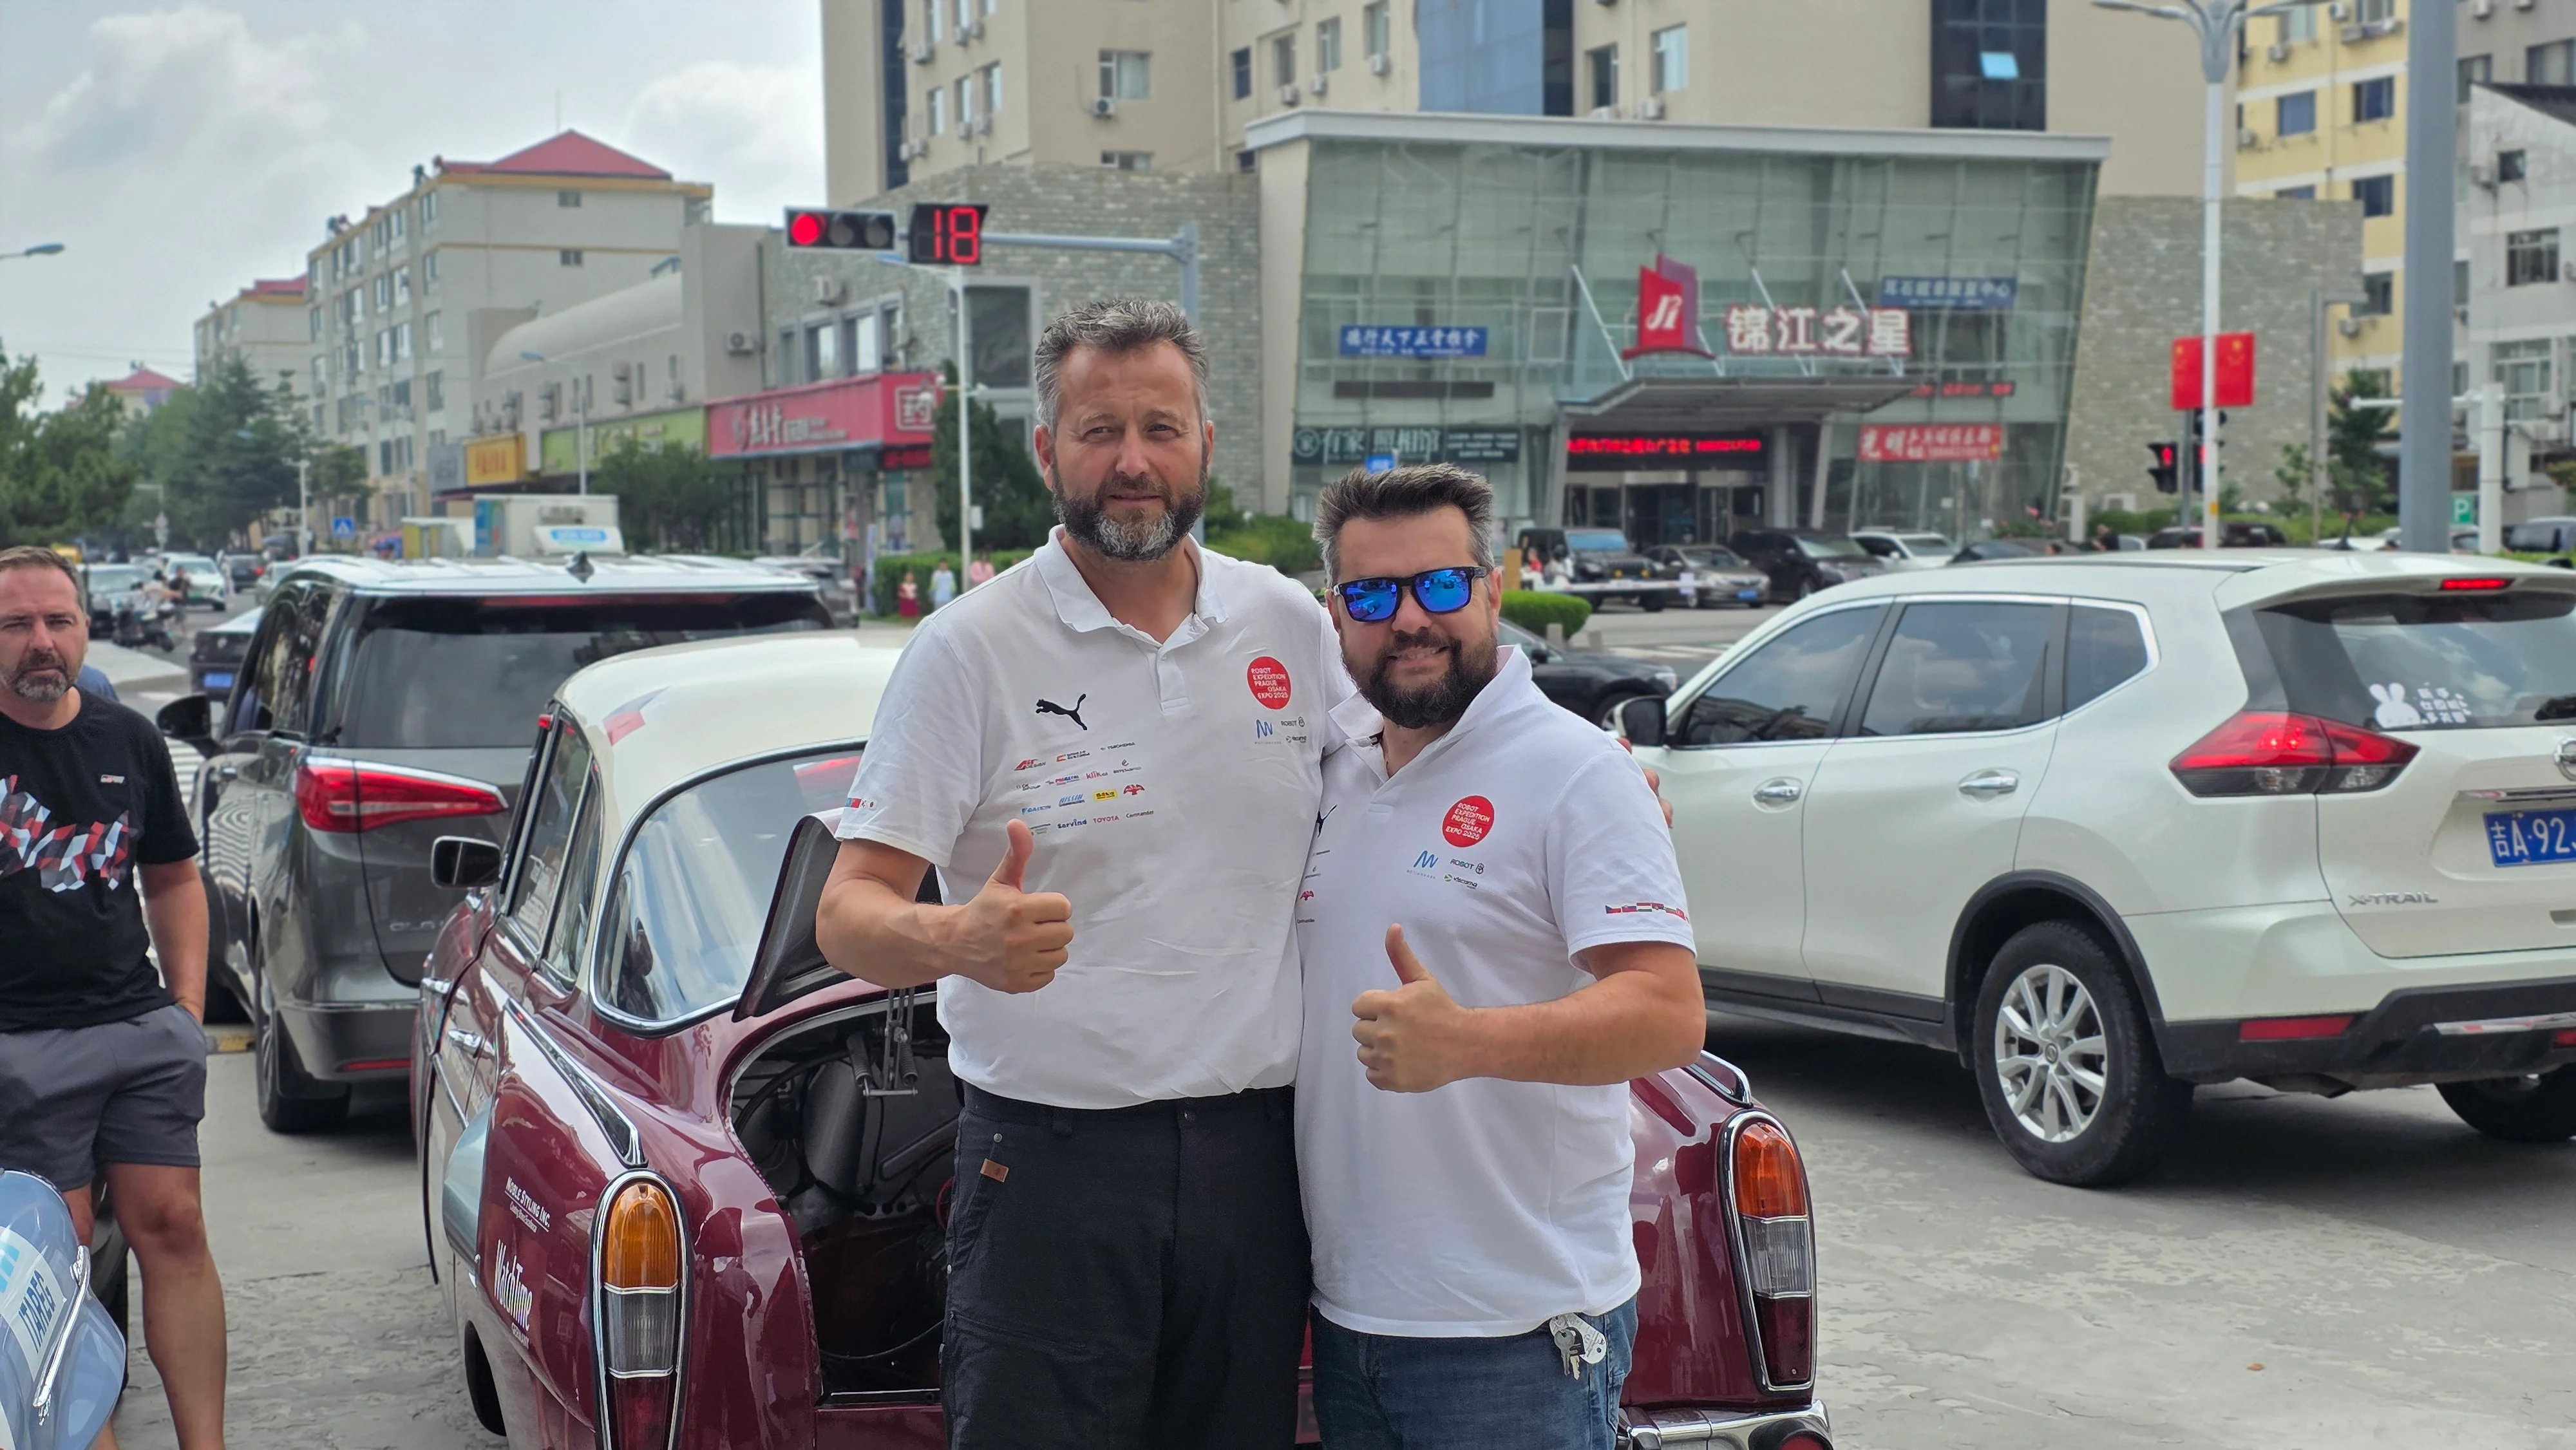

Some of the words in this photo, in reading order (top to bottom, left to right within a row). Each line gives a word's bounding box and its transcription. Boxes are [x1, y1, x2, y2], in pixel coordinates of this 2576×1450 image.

[934, 206, 979, 264] 18
[1727, 305, 1910, 355] 锦江之星
[2454, 498, 2470, 523] P
[1457, 802, 1479, 813] ROBOT
[1093, 815, 1119, 824] TOYOTA
[1451, 814, 1476, 825] PRAGUE
[1454, 808, 1491, 823] EXPEDITION
[1445, 825, 1463, 835] EXPO
[1461, 823, 1482, 834] OSAKA
[2490, 817, 2576, 858] 吉A·92
[1450, 858, 1475, 870] ROBOT
[2348, 892, 2439, 906] X-TRAIL
[506, 1176, 522, 1201] NOBLE
[520, 1189, 540, 1218] STYLING
[494, 1239, 533, 1332] WatchTime
